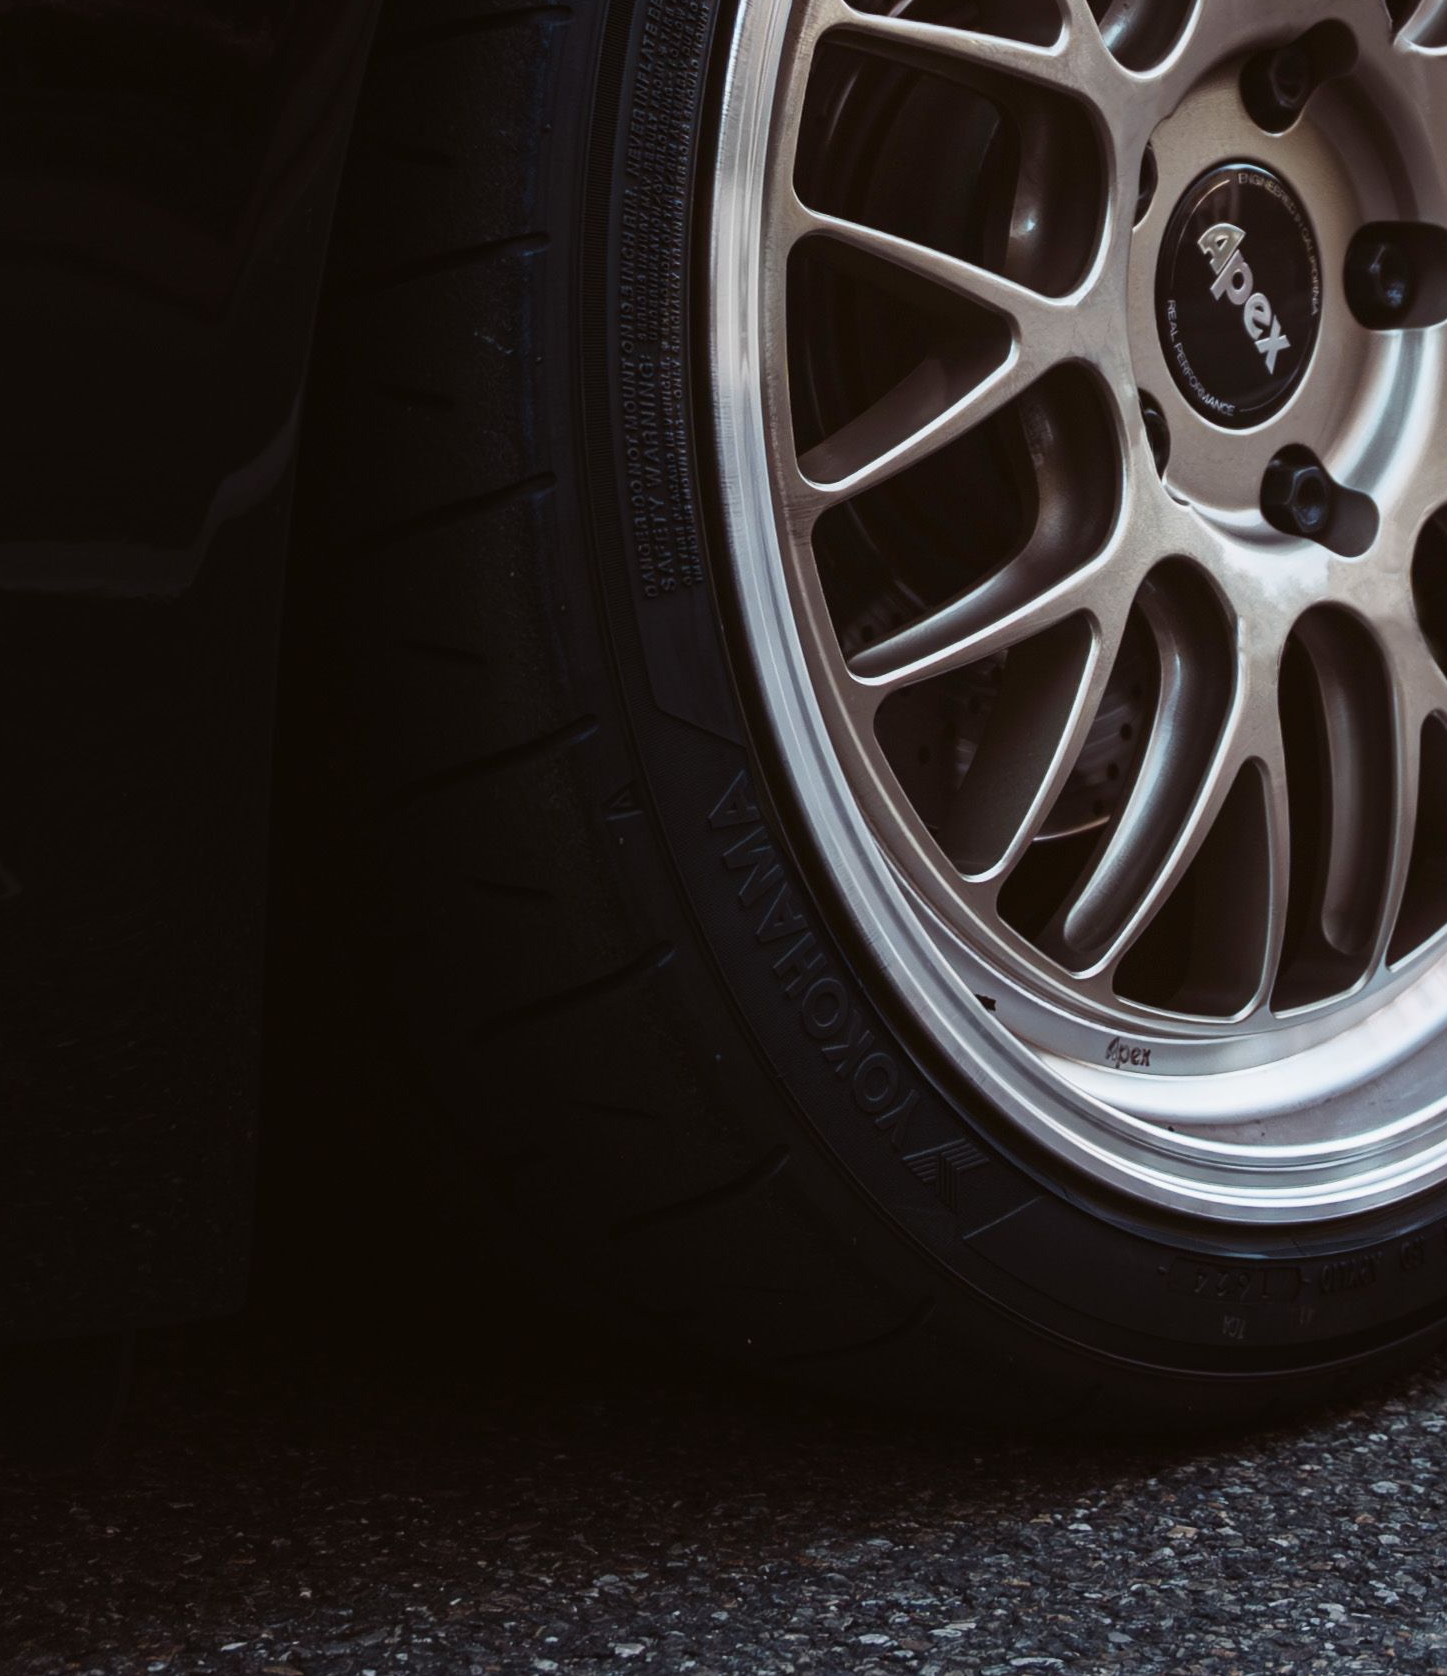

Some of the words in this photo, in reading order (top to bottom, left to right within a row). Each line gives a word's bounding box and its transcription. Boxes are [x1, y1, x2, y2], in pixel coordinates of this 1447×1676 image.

[633, 21, 658, 105] INFLATE
[625, 108, 646, 176] NEVER
[1197, 223, 1291, 375] Apex
[621, 357, 637, 429] MOUNT
[1167, 300, 1177, 343] REAL
[1174, 343, 1236, 416] PERFORMANCE
[638, 354, 662, 487] WARNING:
[648, 495, 676, 591] SAFETY
[706, 769, 920, 1151] YOKOHAMA
[1104, 1036, 1152, 1069] Apex
